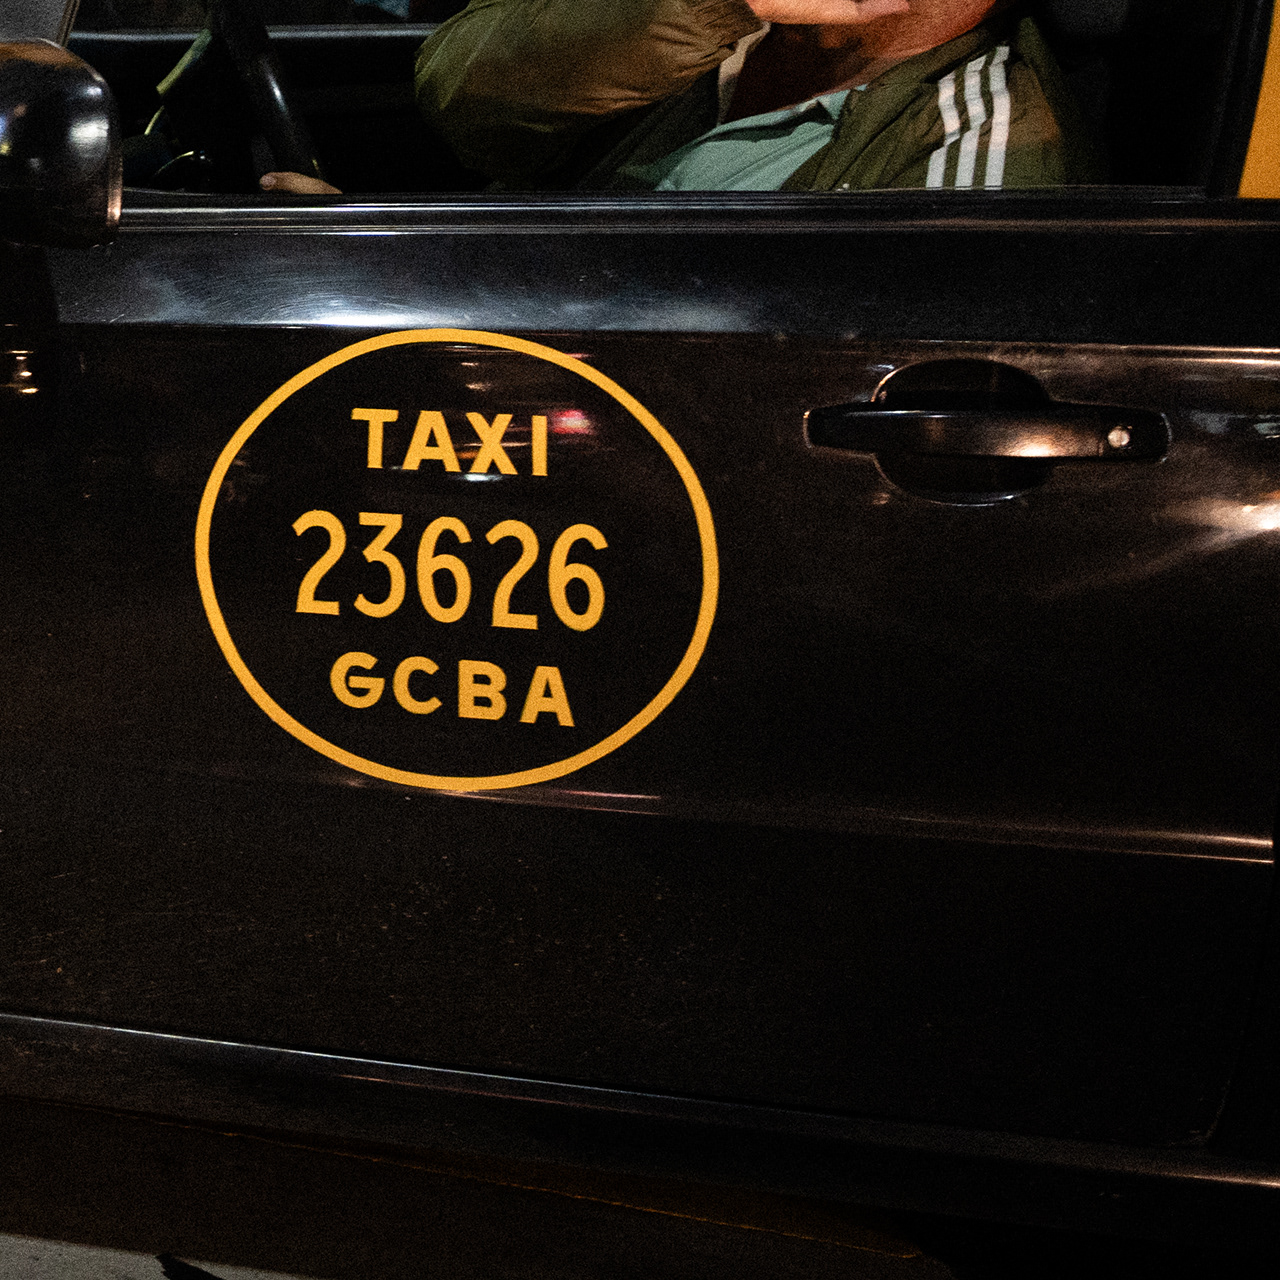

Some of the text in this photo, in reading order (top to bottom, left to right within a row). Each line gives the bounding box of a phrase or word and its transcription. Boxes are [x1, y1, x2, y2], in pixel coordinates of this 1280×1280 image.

[351, 407, 548, 477] TAXI
[292, 509, 609, 632] 23626
[330, 651, 575, 727] GCBA
